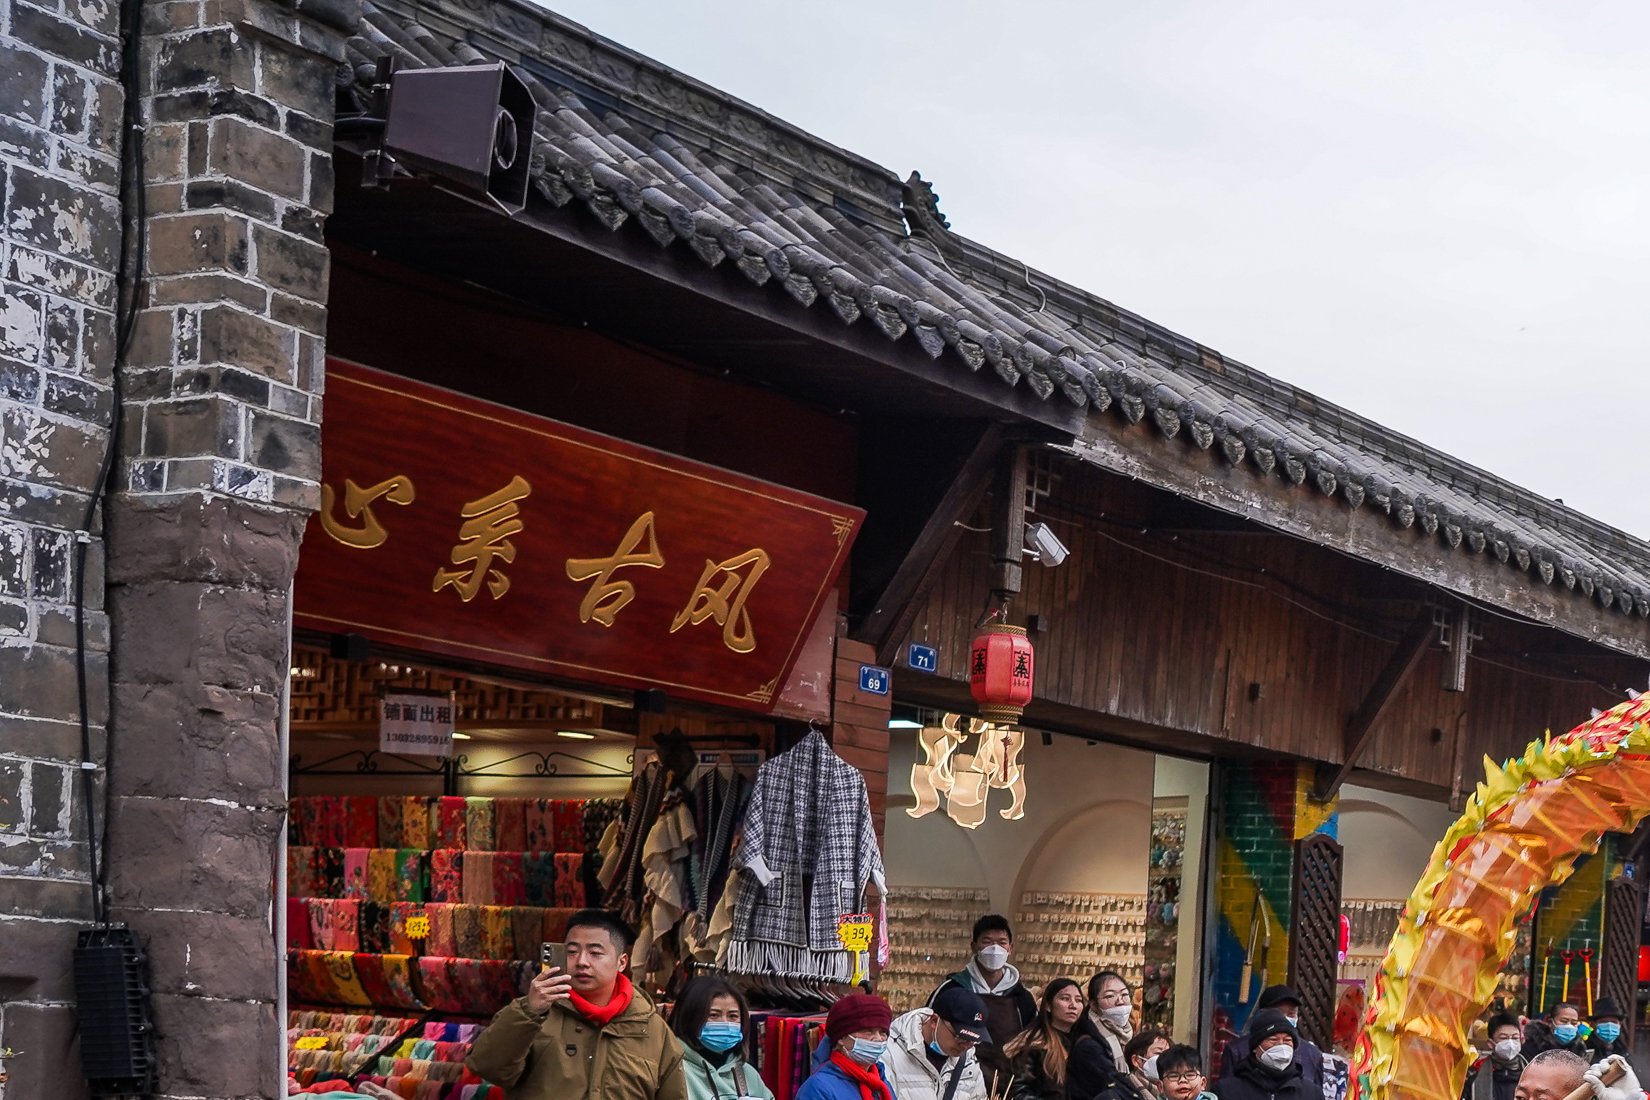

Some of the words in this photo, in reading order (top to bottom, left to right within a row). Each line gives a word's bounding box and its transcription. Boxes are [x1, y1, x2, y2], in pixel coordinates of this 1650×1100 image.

[917, 655, 929, 668] 71
[868, 678, 881, 690] 69
[384, 702, 452, 724] 铺面出租
[842, 915, 871, 924] 大特价
